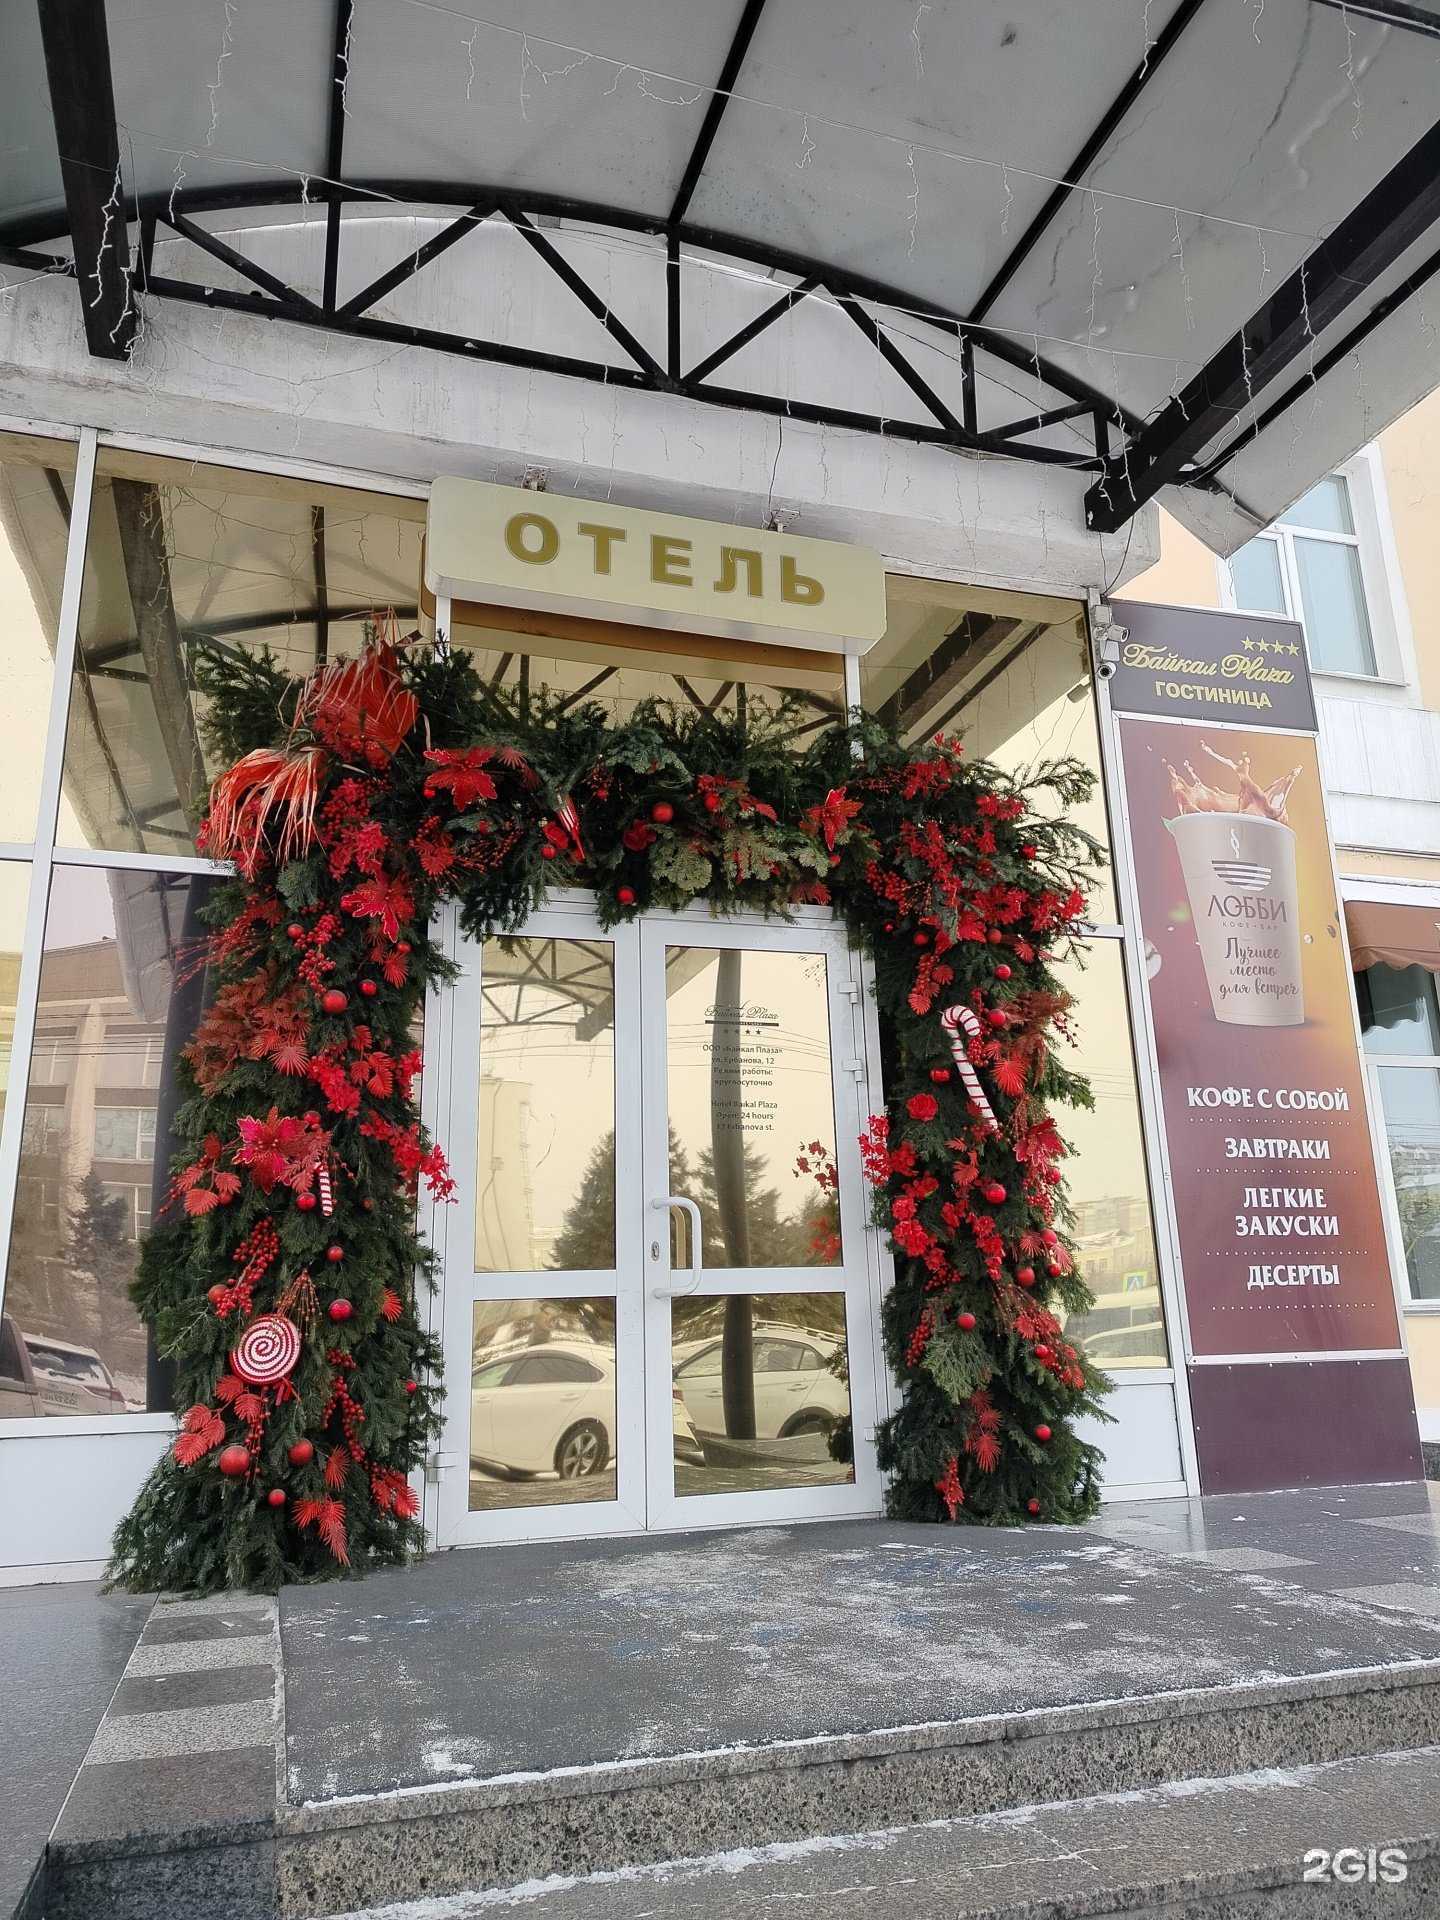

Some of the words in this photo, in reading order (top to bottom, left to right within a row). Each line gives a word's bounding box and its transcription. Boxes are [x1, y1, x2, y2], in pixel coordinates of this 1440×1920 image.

[504, 511, 826, 607] ОТЕЛЬ
[1122, 643, 1217, 676] Байкал
[1220, 653, 1295, 685] Plaza
[1154, 680, 1273, 709] ГОСТИНИЦА
[1207, 894, 1288, 923] ЛОББИ
[1224, 937, 1281, 965] Лучшее
[1230, 965, 1277, 977] место
[1219, 983, 1251, 1000] для
[1187, 1087, 1254, 1107] КОФЕ
[1257, 1089, 1273, 1108] С
[1275, 1088, 1349, 1111] СОБОЙ
[1224, 1137, 1331, 1159] ЗАВТРАКИ
[1243, 1187, 1327, 1208] ЛЕГКИЕ
[1235, 1215, 1340, 1236] ЗАКУСКИ
[1247, 1264, 1340, 1290] ДЕСЕРТЫ
